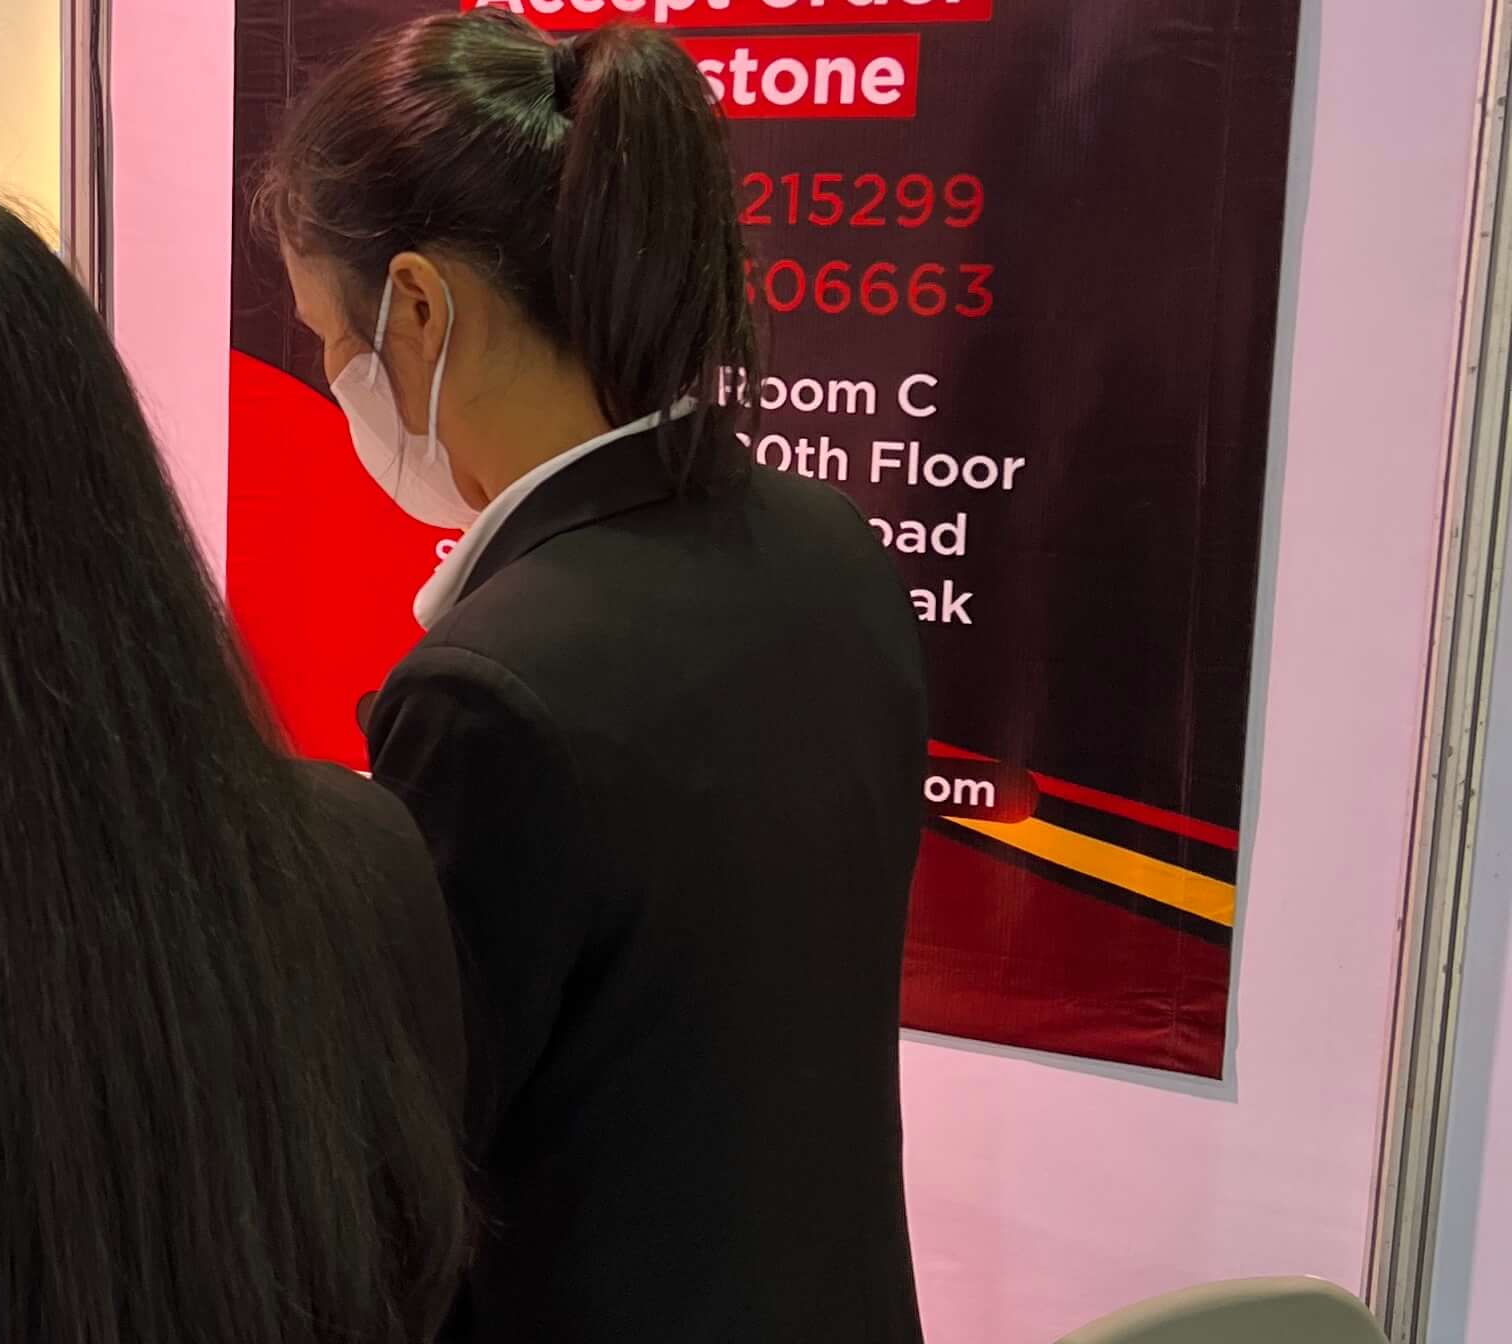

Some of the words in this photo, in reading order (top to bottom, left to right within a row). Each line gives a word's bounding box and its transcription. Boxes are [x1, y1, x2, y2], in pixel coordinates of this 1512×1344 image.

[738, 171, 985, 229] 215299
[898, 373, 939, 418] C
[735, 431, 849, 482] 0th
[870, 440, 1026, 491] Floor
